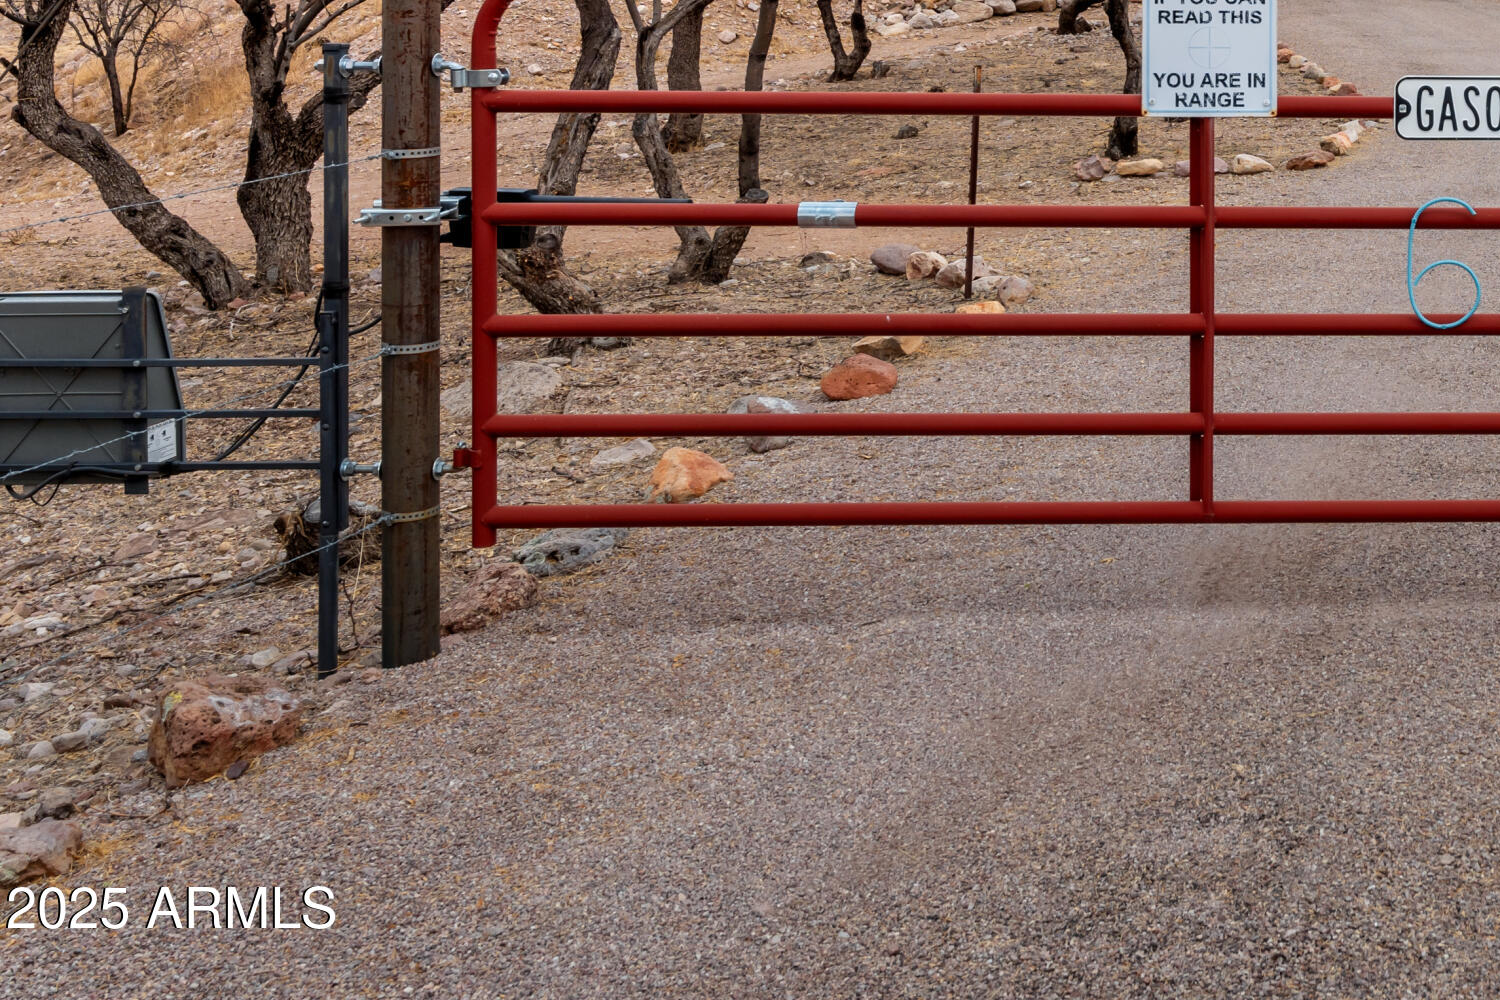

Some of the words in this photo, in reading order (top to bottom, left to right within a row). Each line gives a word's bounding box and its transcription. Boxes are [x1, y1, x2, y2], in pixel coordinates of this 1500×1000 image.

[1158, 10, 1212, 24] READ
[1219, 10, 1262, 24] THIS
[1153, 73, 1194, 88] YOU
[1200, 73, 1241, 88] ARE
[1247, 73, 1266, 88] IN
[1175, 92, 1245, 107] RANGE
